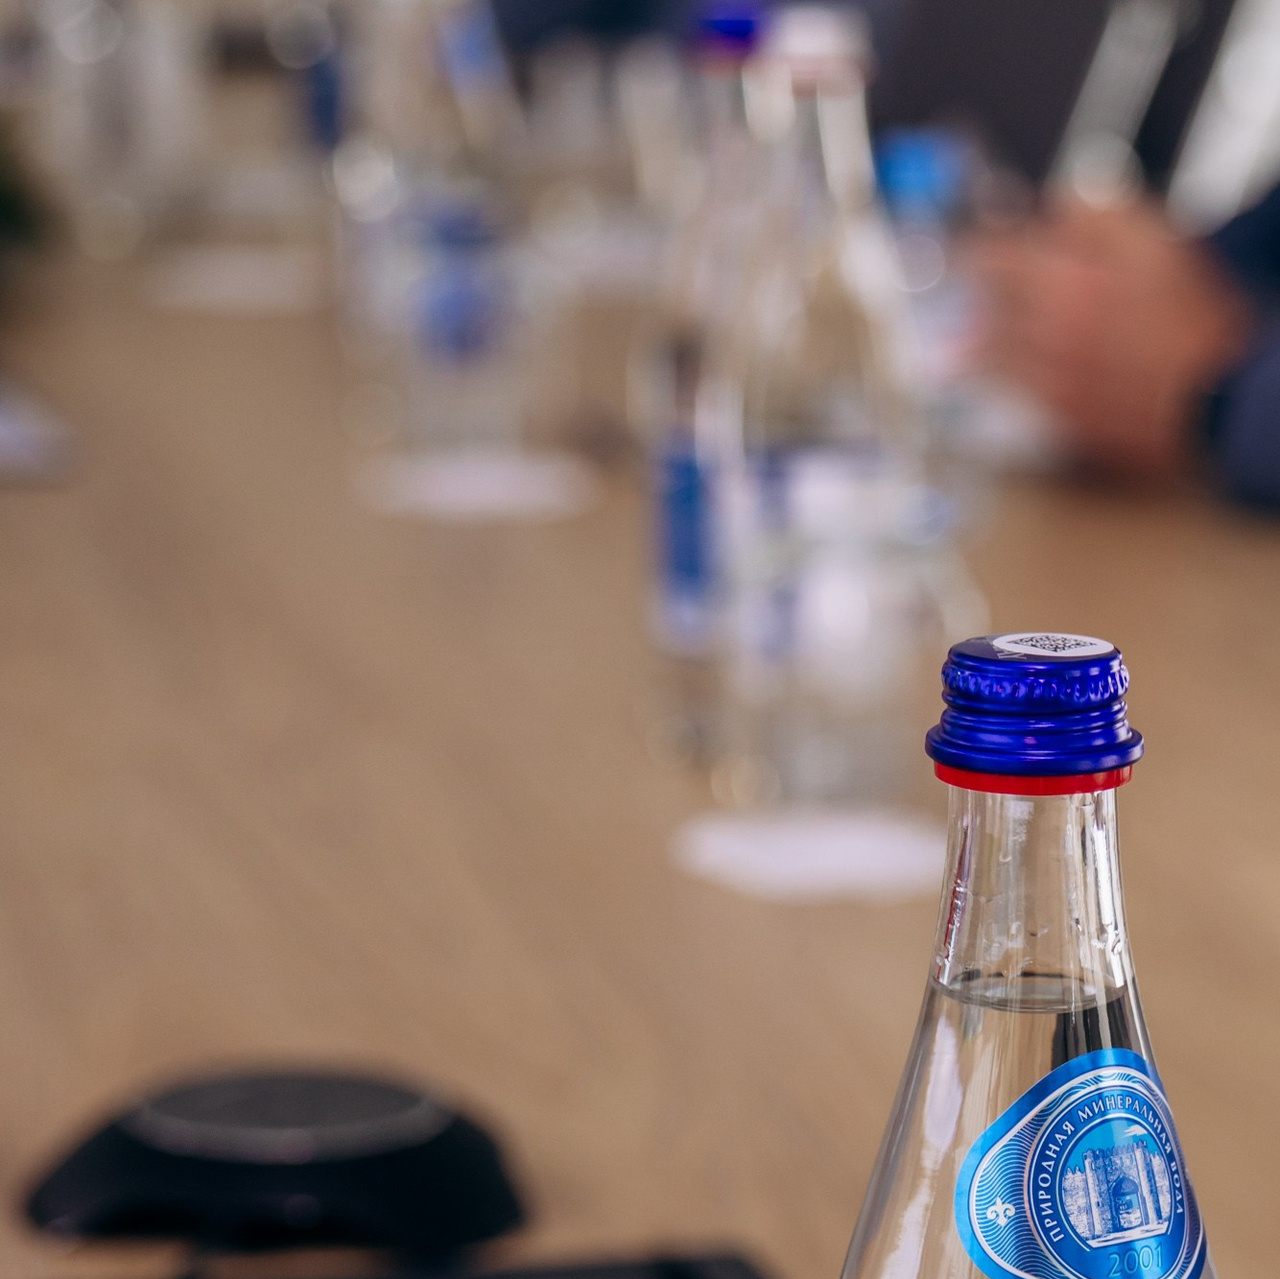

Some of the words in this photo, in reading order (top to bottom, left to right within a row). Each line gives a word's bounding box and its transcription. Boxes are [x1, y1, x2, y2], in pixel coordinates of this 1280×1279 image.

[1037, 1121, 1076, 1243] ПРИРОДНАЯ
[1078, 1094, 1172, 1154] МИНЕРАЛЬНАЯ
[1170, 1161, 1184, 1215] ВОДА
[1107, 1244, 1163, 1278] 2001
